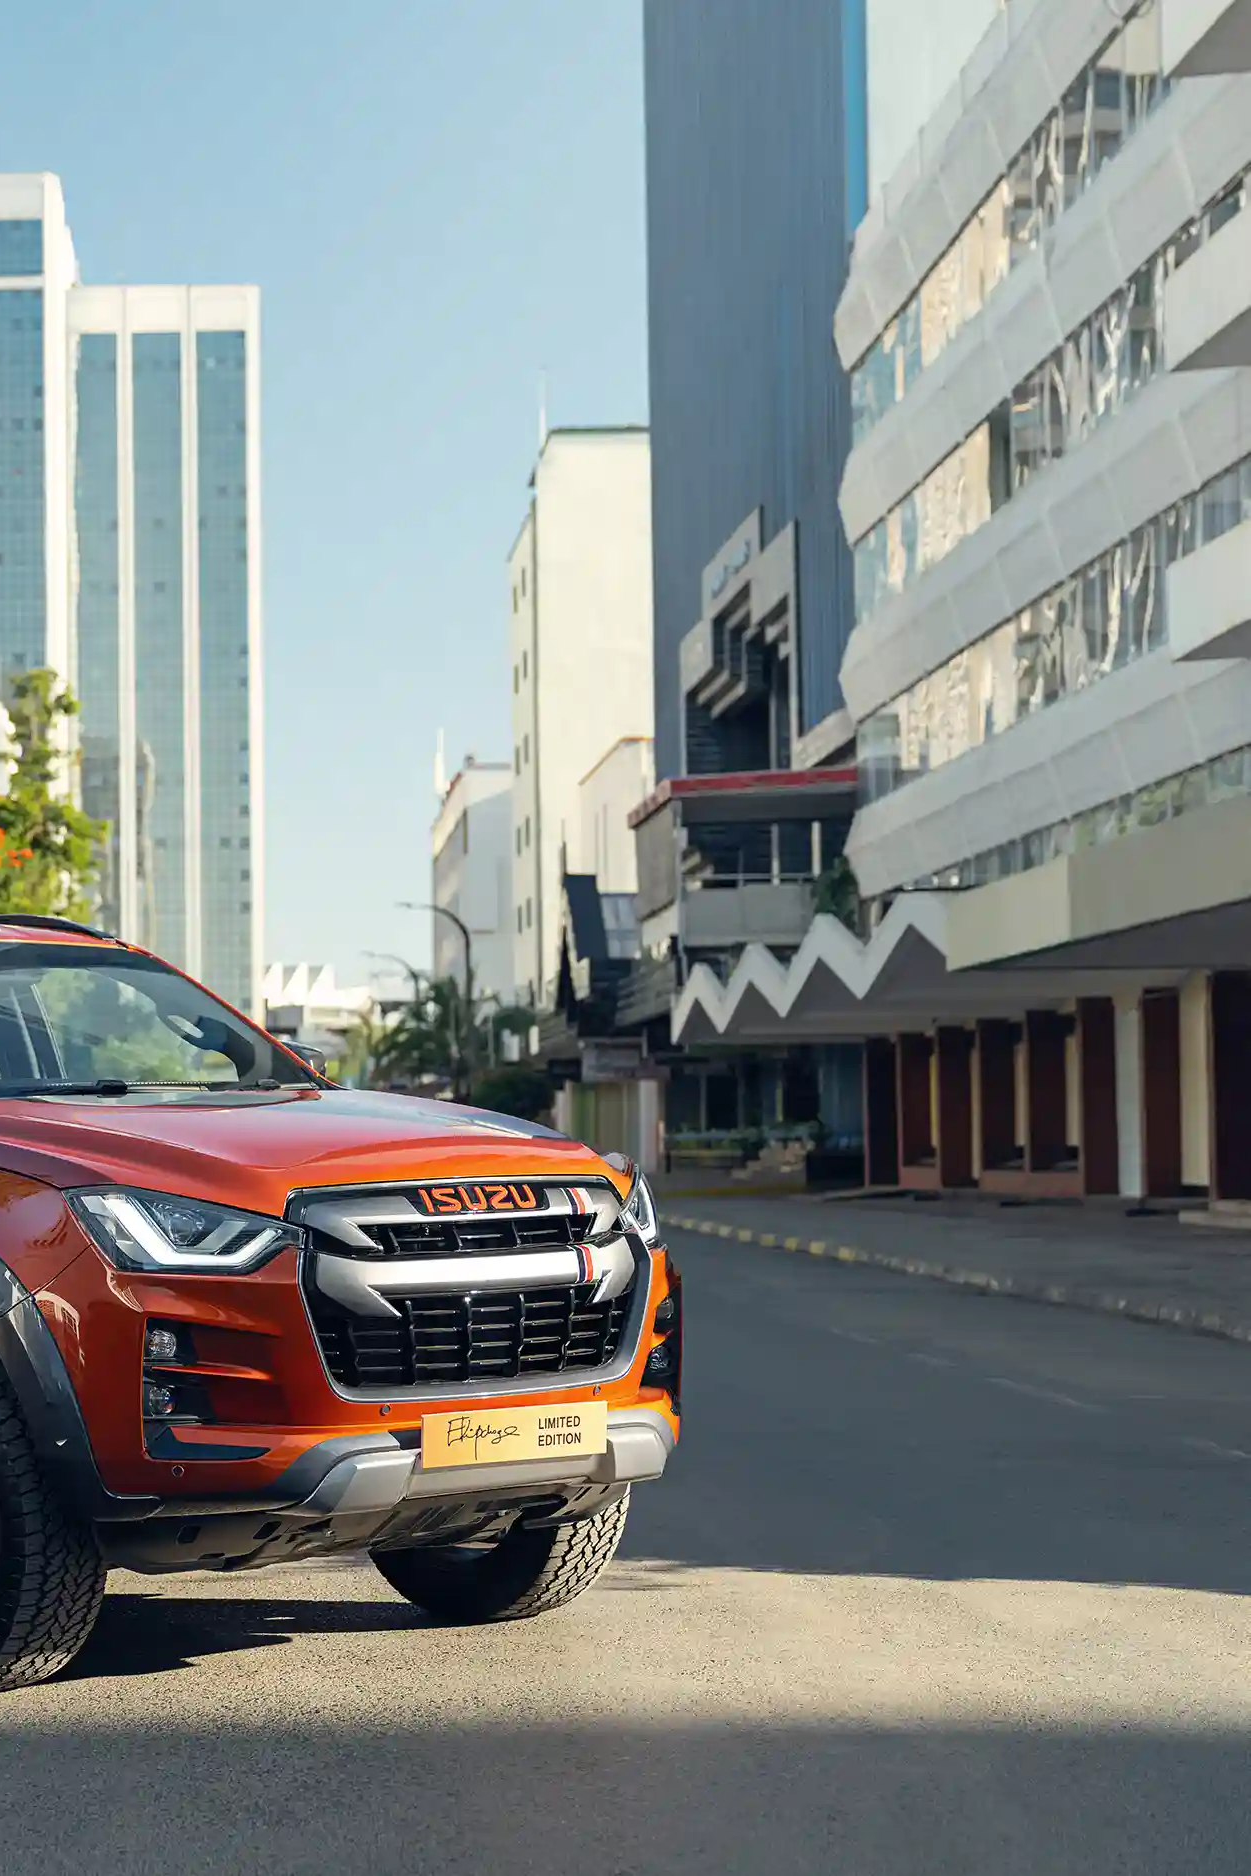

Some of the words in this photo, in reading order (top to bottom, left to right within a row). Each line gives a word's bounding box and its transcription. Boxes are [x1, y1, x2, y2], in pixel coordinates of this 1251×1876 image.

[417, 1184, 537, 1213] ISUZU
[538, 1415, 581, 1430] LIMITED
[538, 1432, 582, 1447] EDITION
